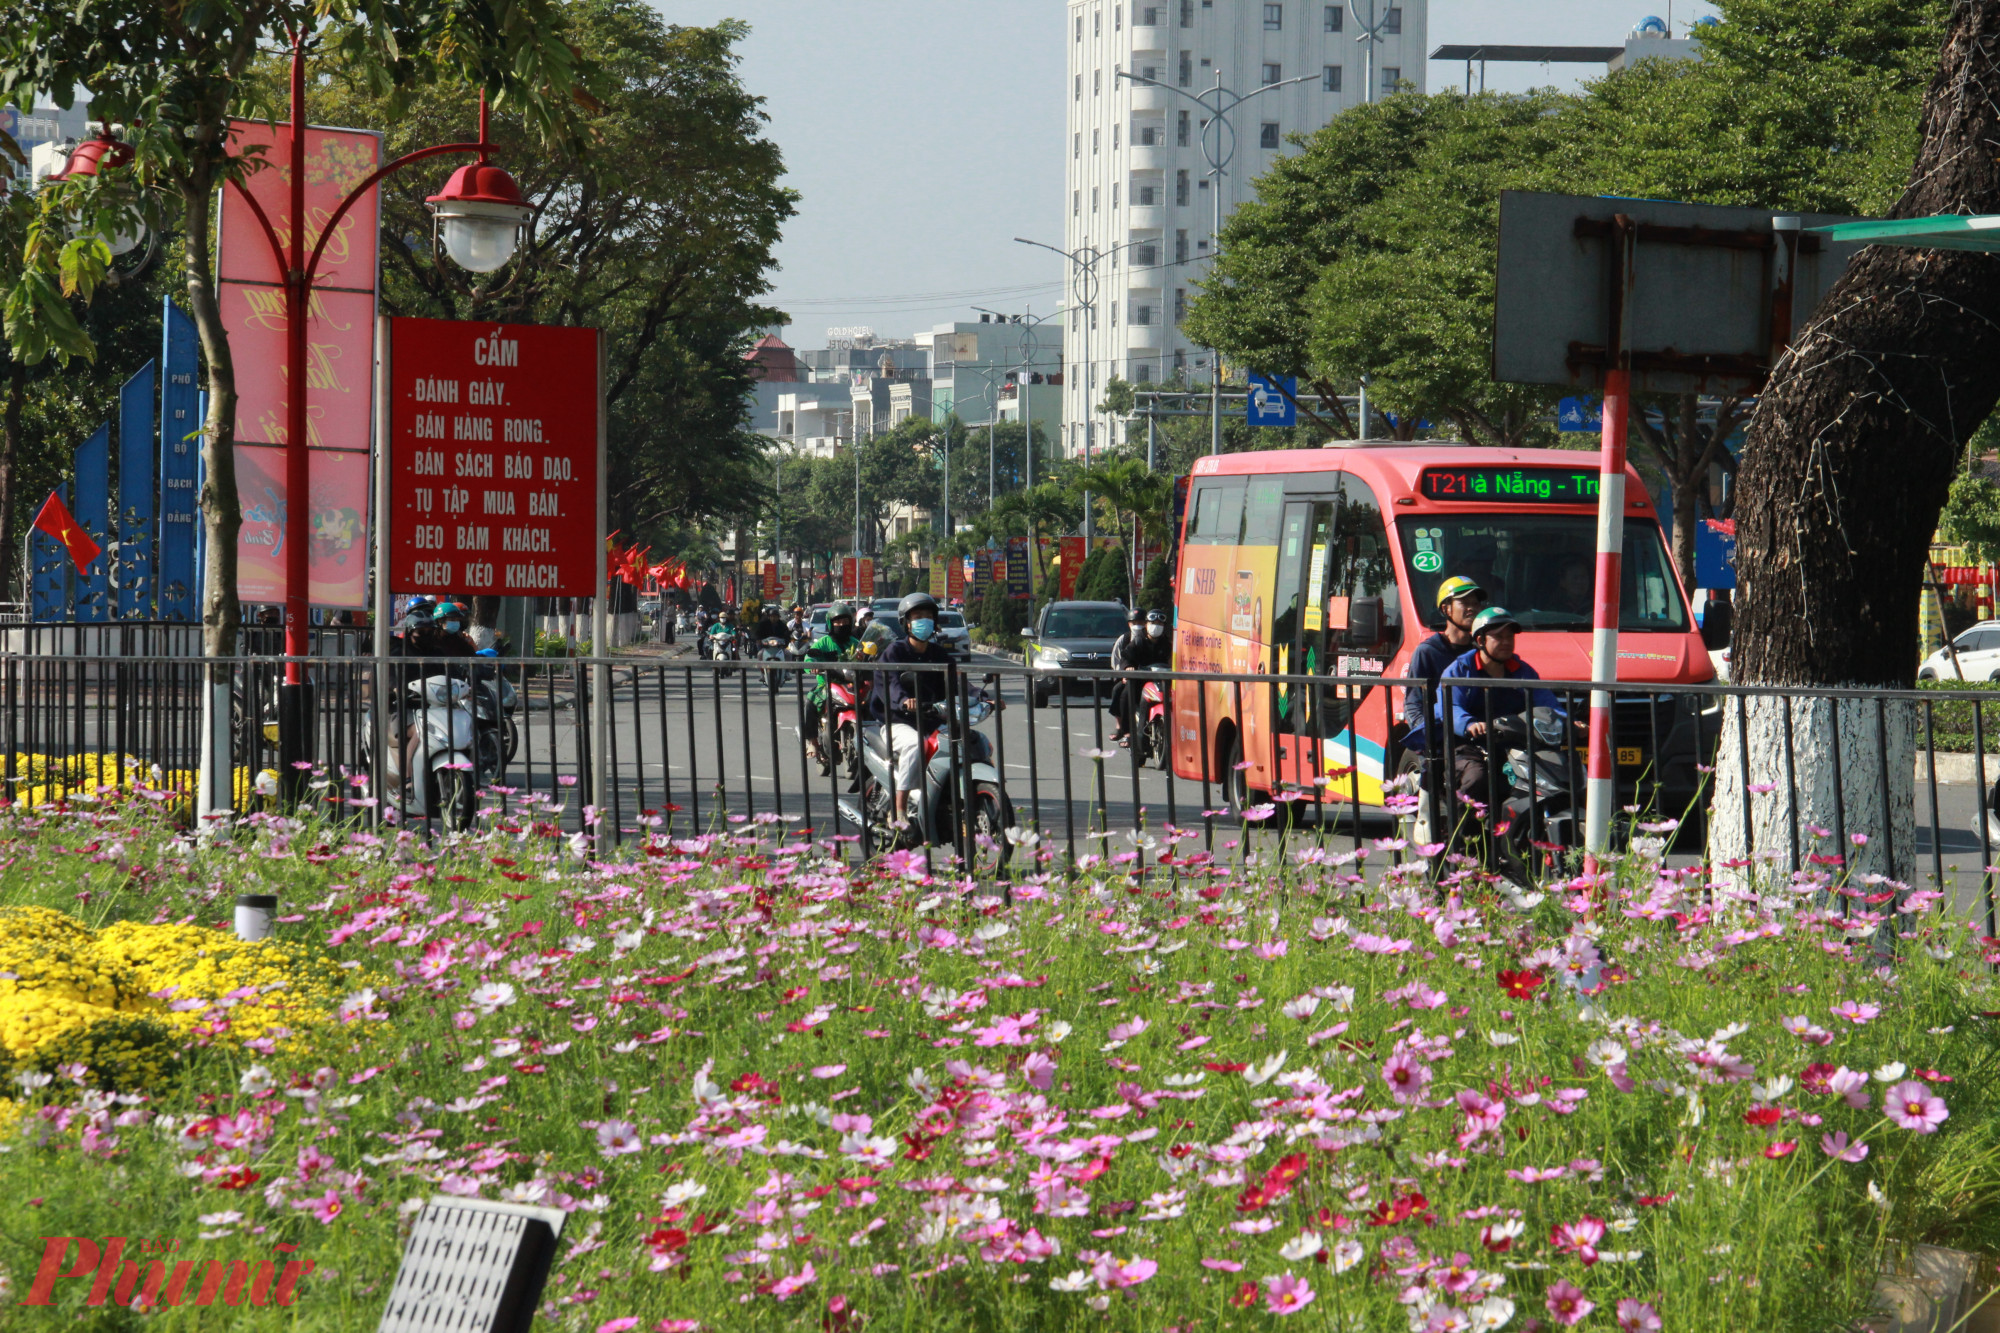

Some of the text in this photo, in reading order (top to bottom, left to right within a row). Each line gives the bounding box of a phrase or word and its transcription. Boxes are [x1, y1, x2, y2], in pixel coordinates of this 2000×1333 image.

[827, 326, 872, 336] GOLD HOTEL
[474, 327, 519, 367] CẤM
[453, 412, 493, 442] HÀNG
[455, 449, 493, 478] SÁCH
[504, 452, 533, 479] BÁO
[168, 479, 192, 490] BẠCH
[1427, 473, 1467, 493] T21
[1471, 474, 1488, 493] à
[1495, 471, 1550, 498] Nẵng
[443, 484, 469, 520] TẬP
[483, 490, 516, 516] MUA
[456, 522, 489, 551] BÁM
[465, 558, 493, 587] KÉO
[1417, 555, 1437, 567] 21
[1195, 568, 1216, 595] SHB
